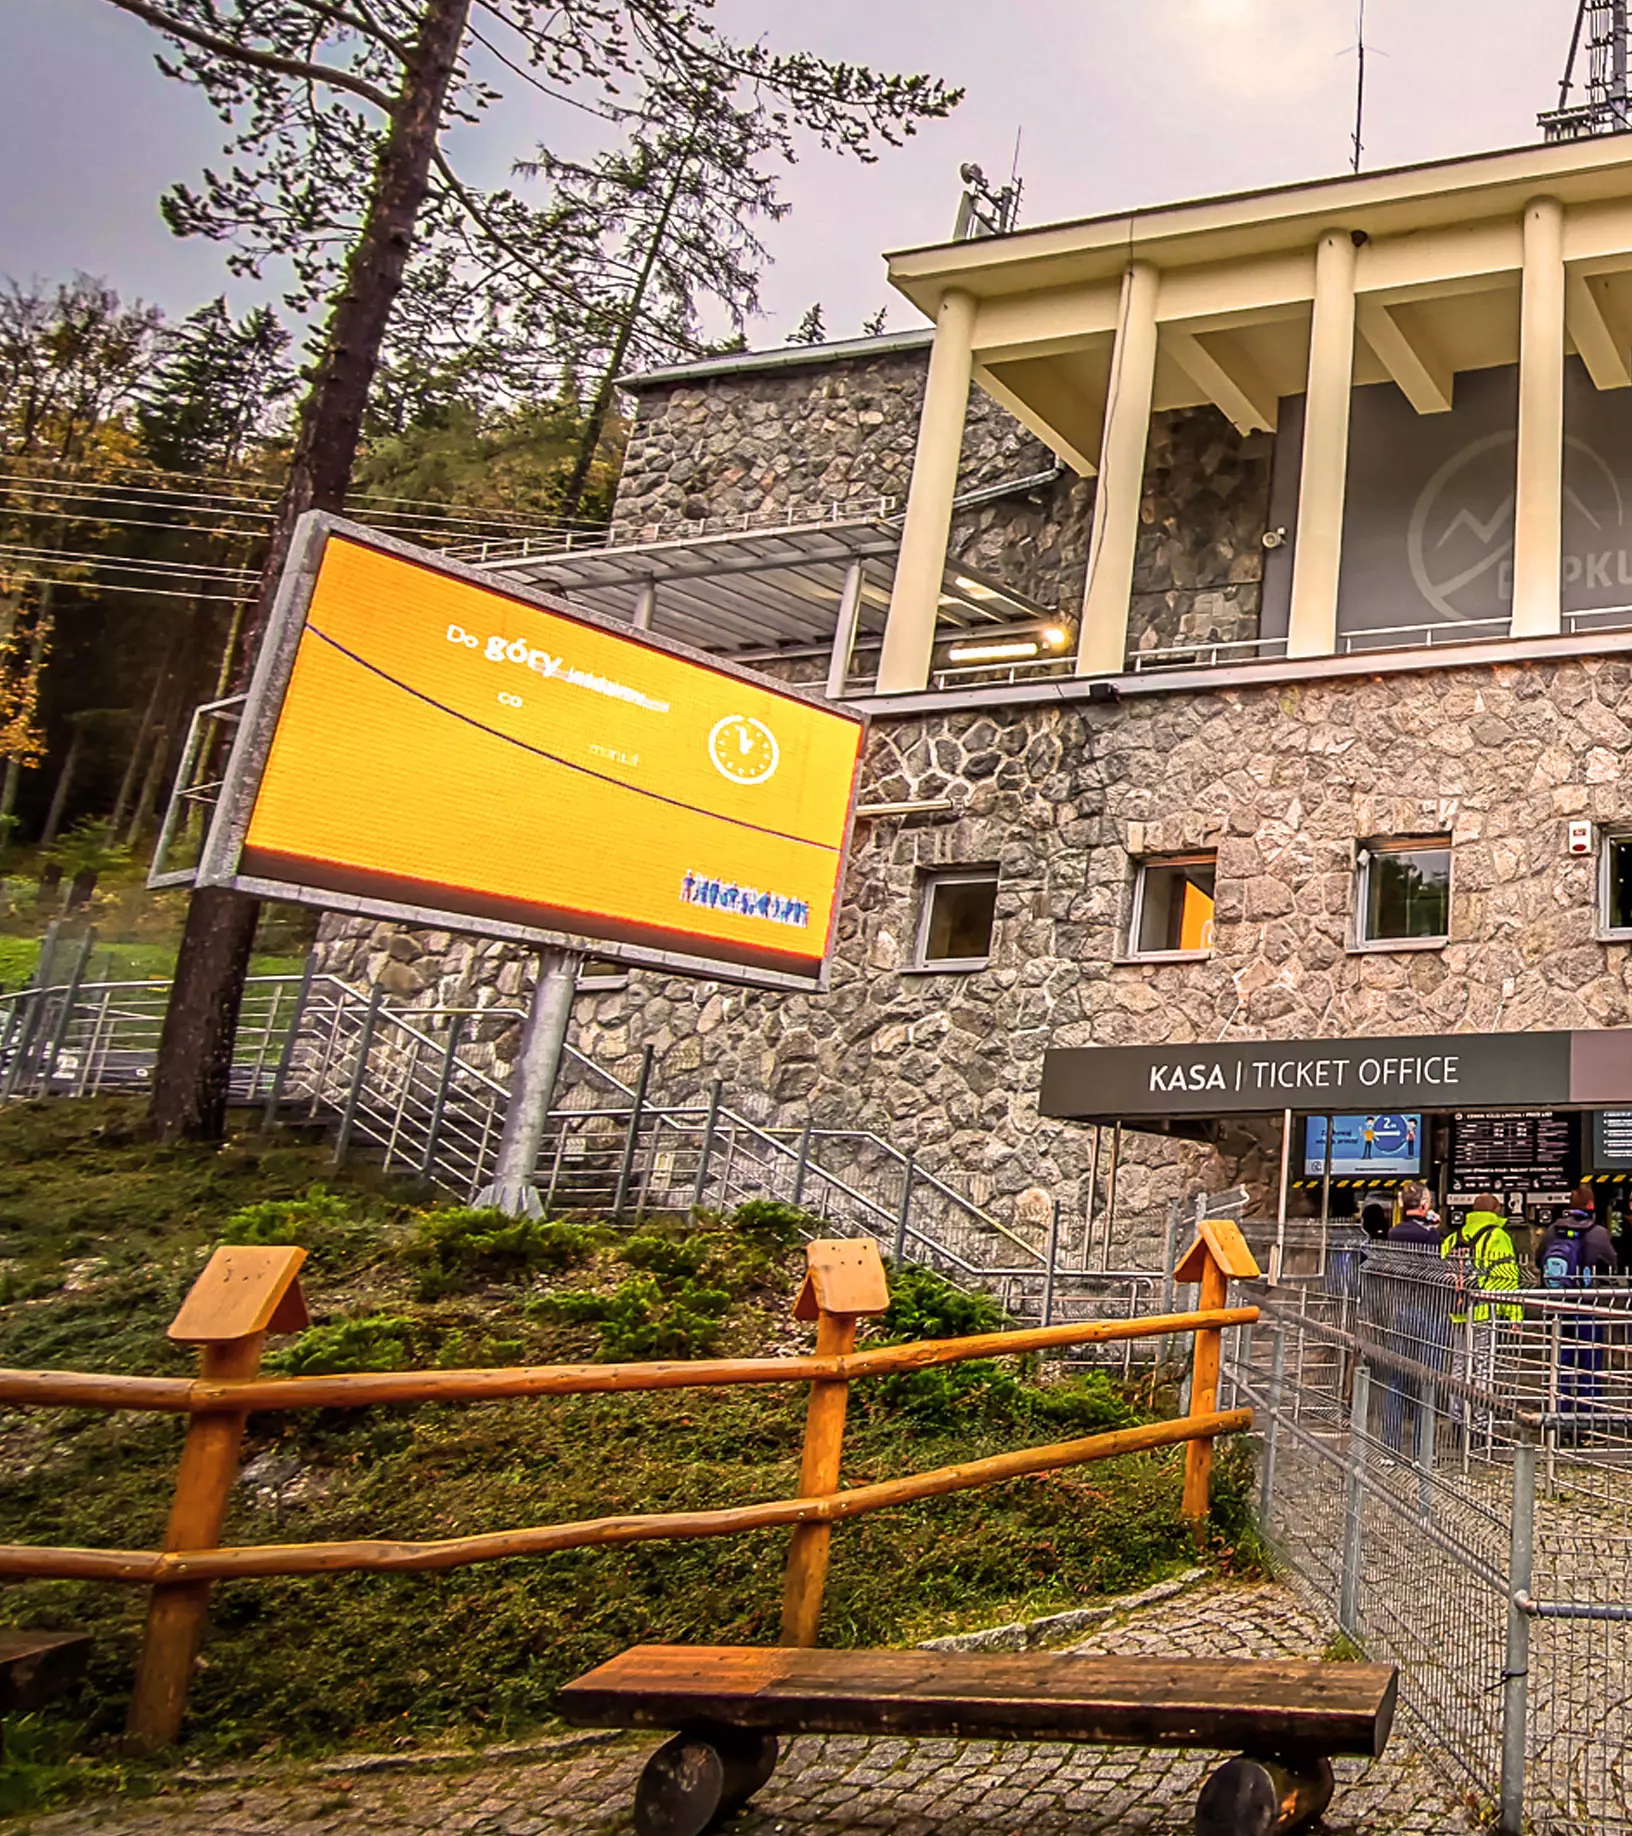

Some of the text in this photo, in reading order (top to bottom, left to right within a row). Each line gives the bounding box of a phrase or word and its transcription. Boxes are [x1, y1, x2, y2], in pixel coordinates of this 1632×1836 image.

[446, 624, 563, 678] Do góry
[497, 690, 523, 709] co
[1149, 1056, 1460, 1092] KASA TICKET OFFICE
